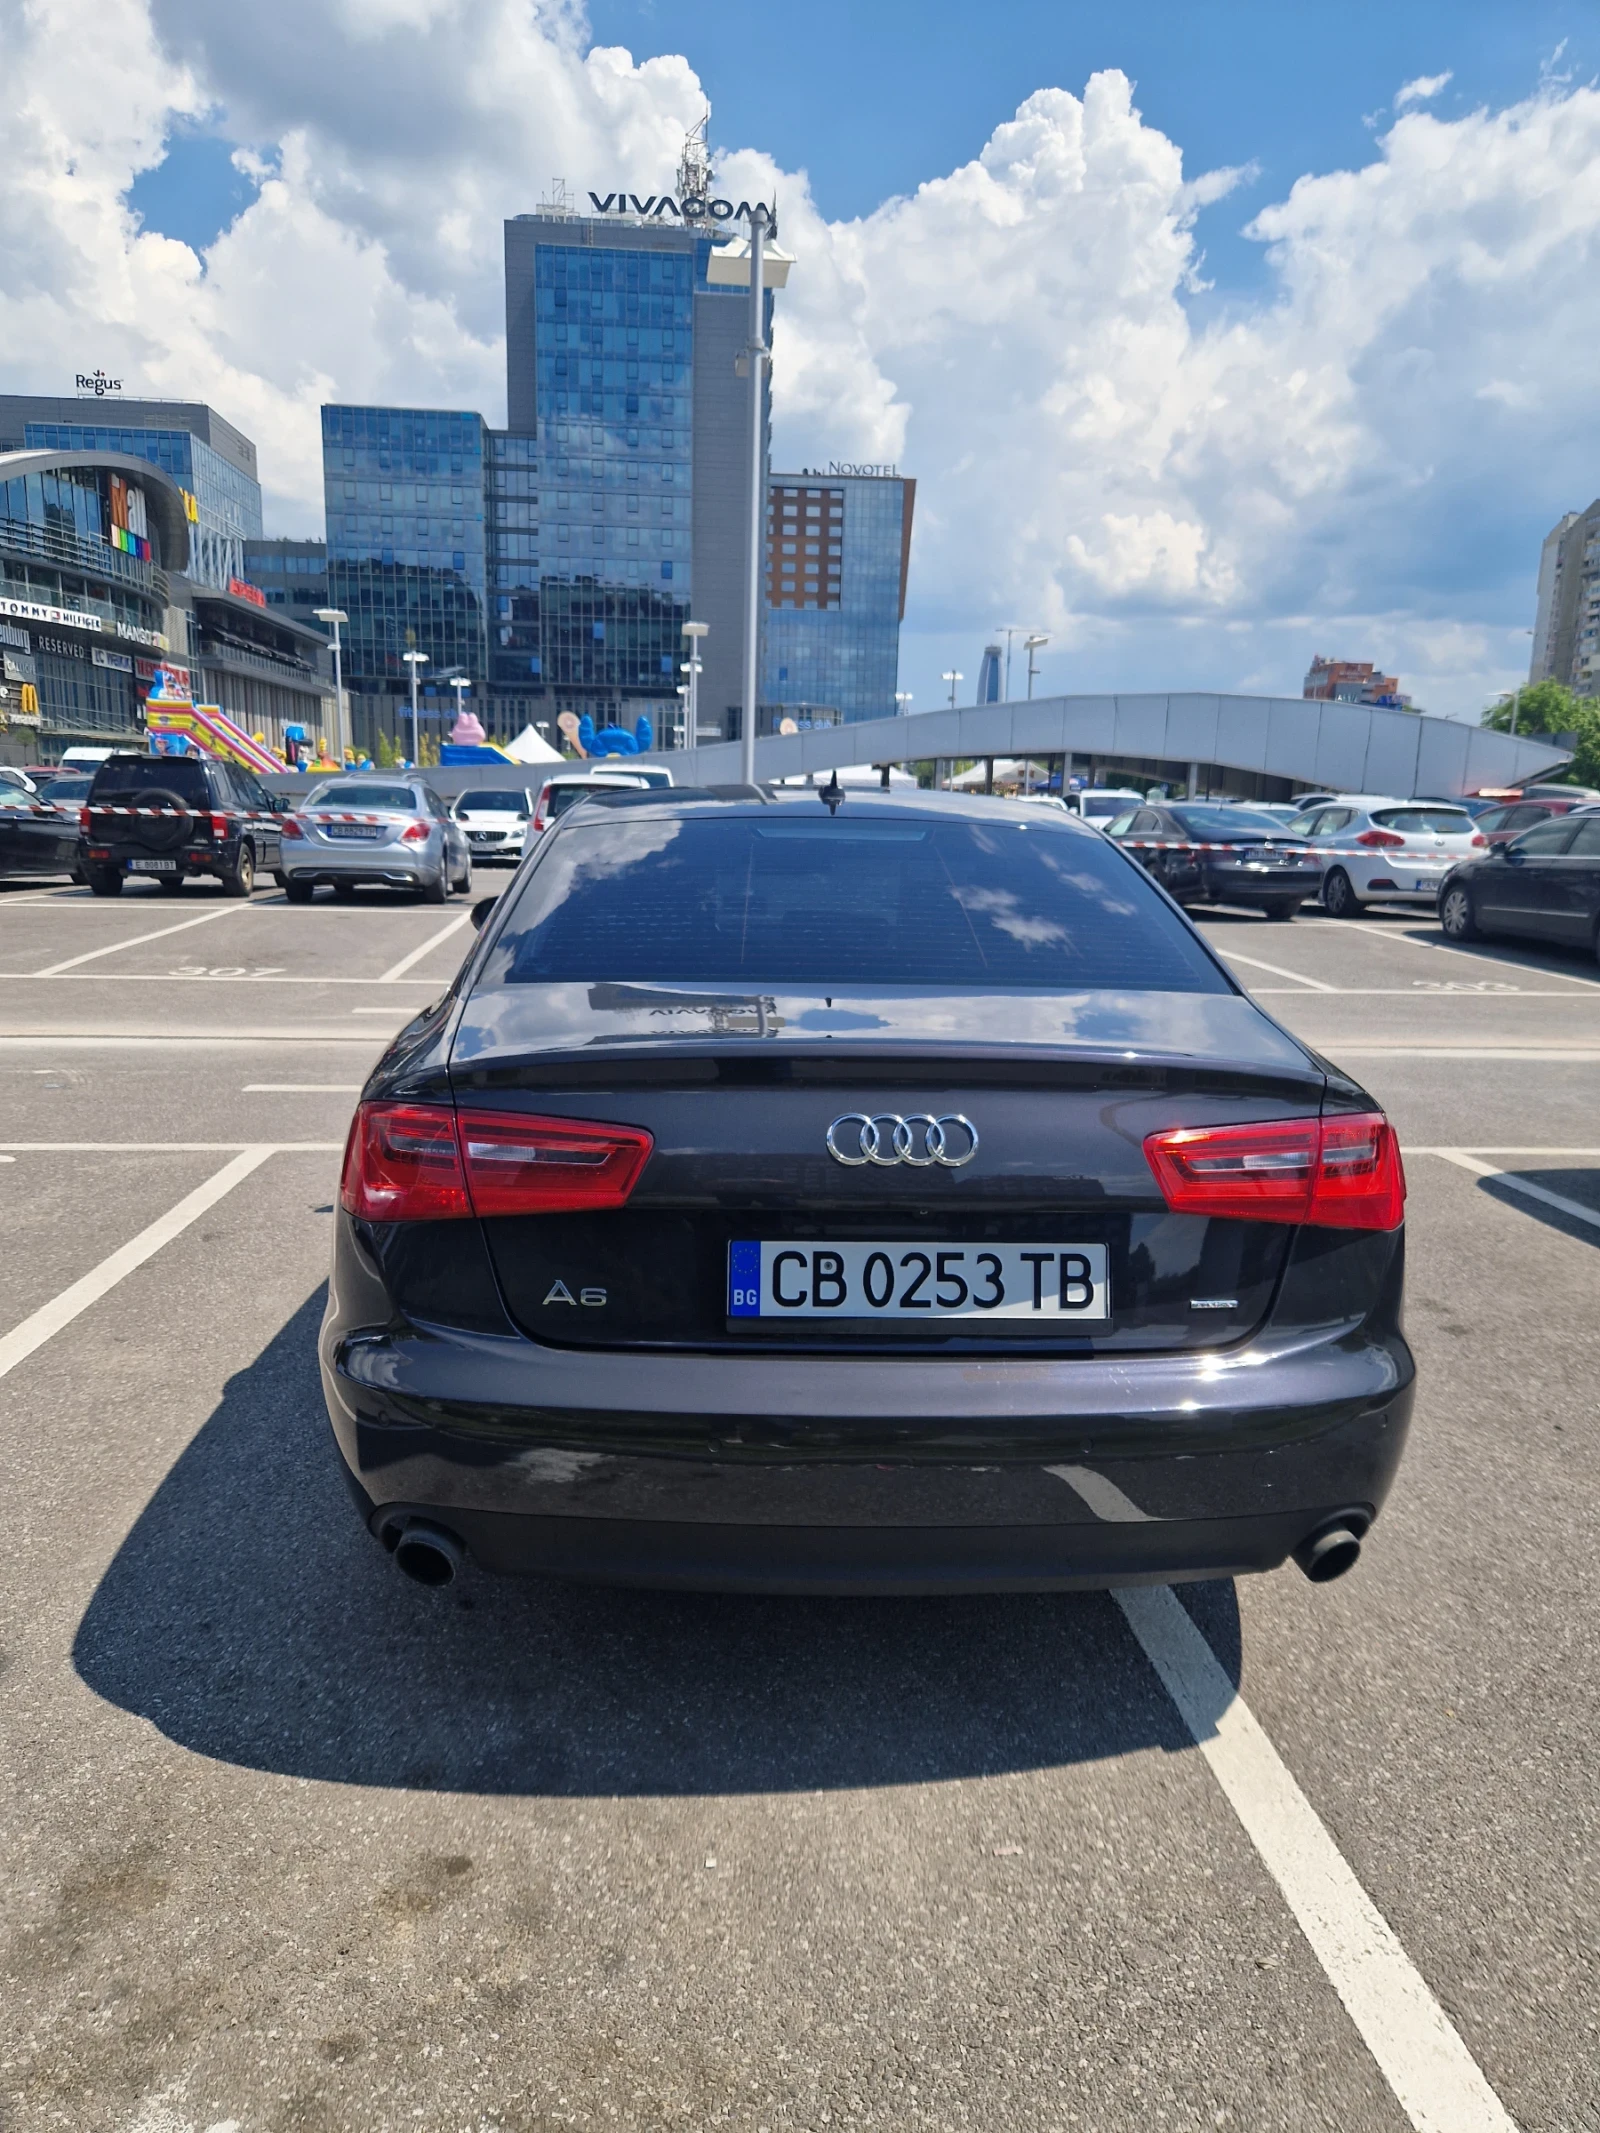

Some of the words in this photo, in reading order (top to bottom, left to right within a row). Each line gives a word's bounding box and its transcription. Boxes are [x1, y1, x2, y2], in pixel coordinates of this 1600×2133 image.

[587, 191, 773, 221] VIVACOM
[76, 374, 122, 396] Regus
[829, 460, 900, 478] NOVOTEL
[0, 601, 48, 618] TOMMY
[63, 612, 101, 629] HILFIGER
[38, 635, 85, 659] RESERVED
[168, 966, 287, 978] 307
[772, 1250, 848, 1308] CB
[862, 1251, 1006, 1309] 0253
[1019, 1252, 1095, 1311] TB
[541, 1279, 607, 1307] A6
[733, 1288, 758, 1306] BG
